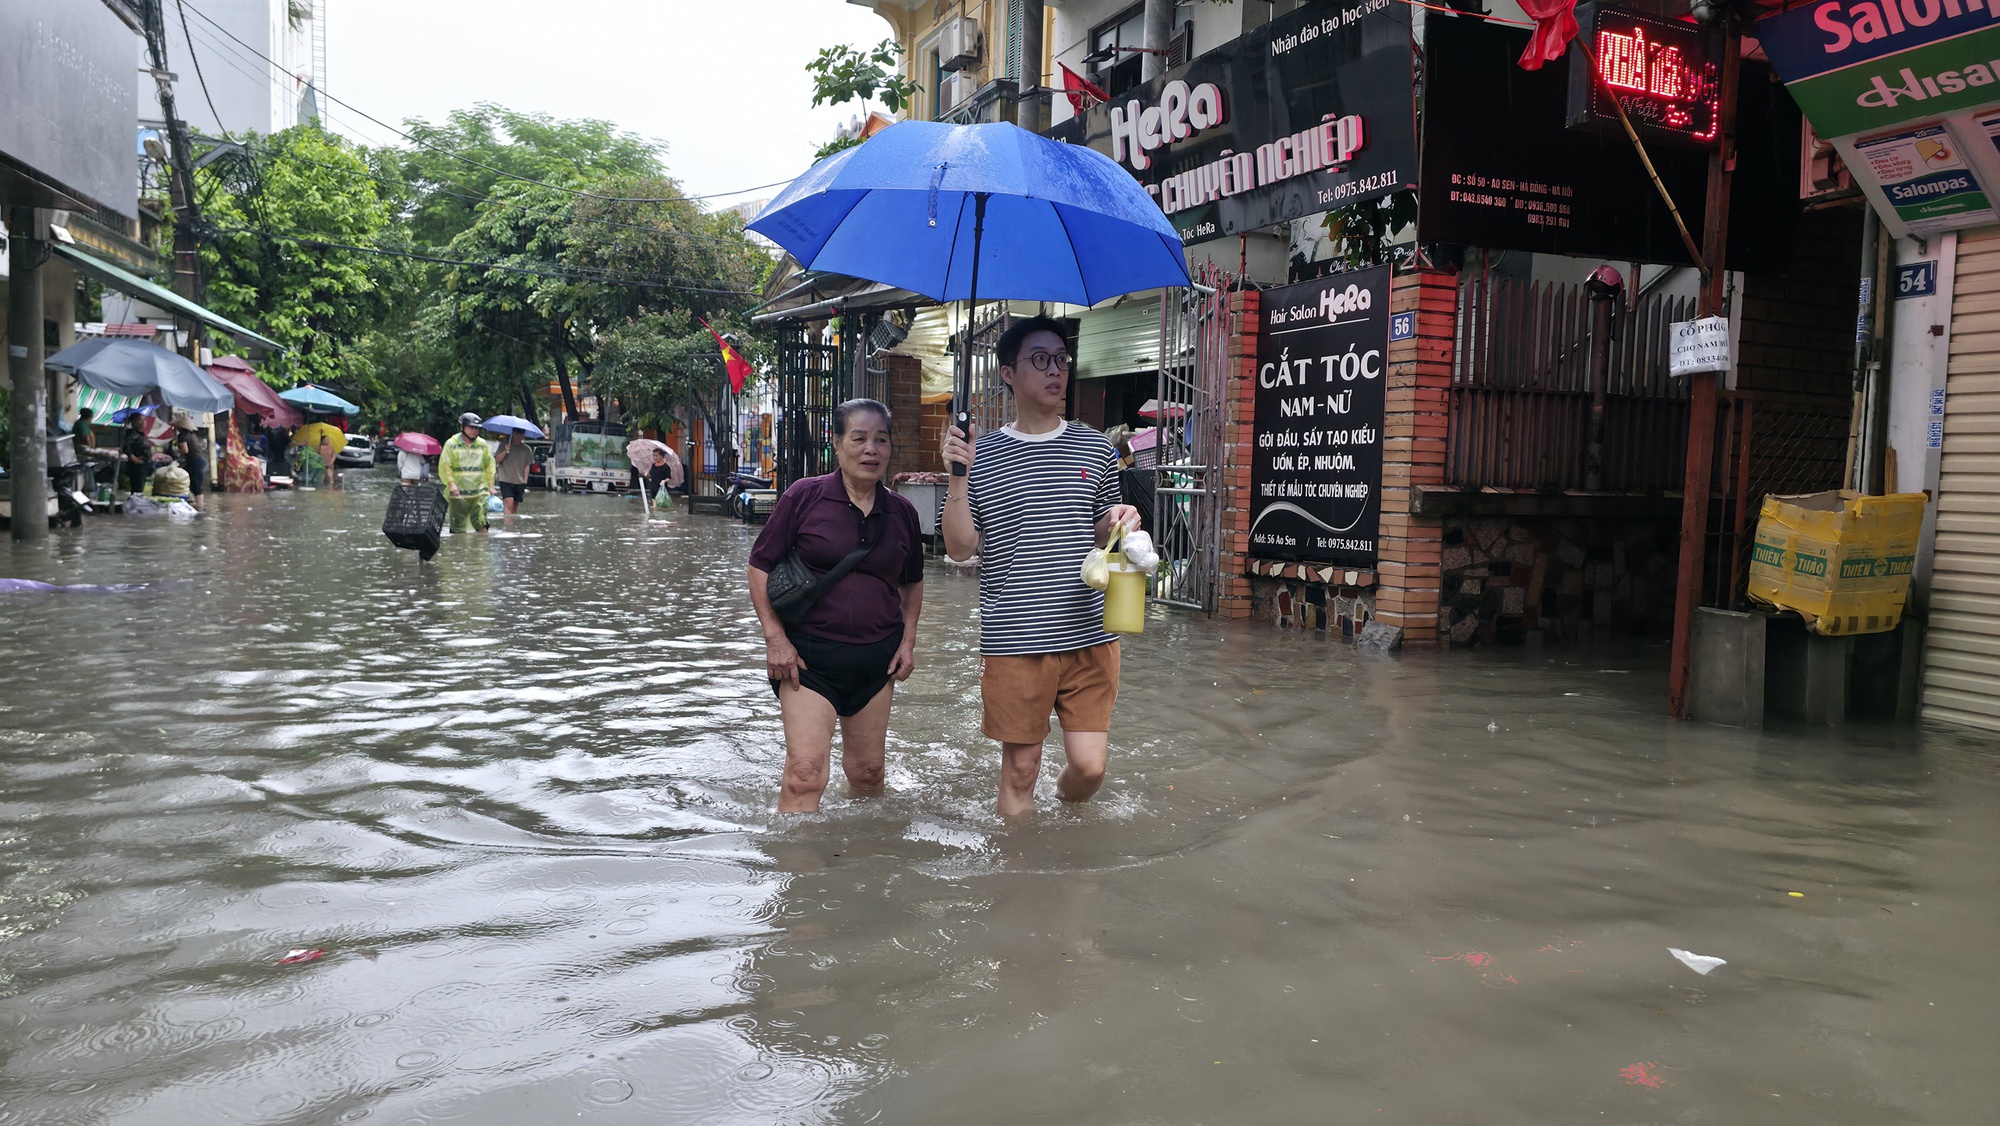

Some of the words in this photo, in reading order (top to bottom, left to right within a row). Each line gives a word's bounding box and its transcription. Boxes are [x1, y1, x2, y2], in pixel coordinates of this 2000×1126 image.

[1271, 33, 1298, 57] Nhận
[1299, 25, 1320, 44] đào
[1321, 16, 1340, 37] tạo
[1342, 4, 1363, 27] học
[1110, 79, 1223, 171] HeRa
[1915, 129, 1927, 138] 20
[1162, 148, 1255, 215] CHUYÊN
[1256, 112, 1364, 188] NGHIỆP
[1318, 191, 1333, 204] Tel:
[1334, 170, 1398, 200] 0975.842.811
[1477, 176, 1486, 187] 50
[1491, 178, 1500, 189] AO
[1501, 179, 1515, 190] SEN
[1892, 176, 1969, 200] Salonpas
[1183, 227, 1195, 241] Tóc
[1196, 221, 1215, 237] HeRa
[1900, 268, 1926, 292] 54
[1270, 308, 1288, 325] Hair
[1290, 304, 1317, 322] Salon
[1319, 284, 1372, 323] HeRa
[1394, 316, 1410, 336] 56
[1677, 345, 1695, 353] CHO
[1697, 340, 1718, 349] NAM
[1260, 346, 1313, 389] CẮT
[1320, 342, 1380, 384] TÓC
[1280, 396, 1314, 418] NAM
[1327, 389, 1353, 414] NỮ
[1303, 426, 1323, 446] SẤY
[1327, 429, 1348, 448] TẠO
[1351, 423, 1376, 445] KIỂU
[1272, 451, 1295, 471] UỐN,
[1297, 453, 1311, 471] ÉP,
[1314, 452, 1356, 472] NHUỘM,
[1261, 479, 1276, 496] THIẾT
[1278, 480, 1286, 496] KẾ
[1305, 481, 1317, 497] TÓC
[1318, 480, 1343, 498] CHUYÊN
[1345, 481, 1368, 499] NGHIỆP
[1254, 534, 1266, 544] Add:
[1267, 534, 1274, 544] 56
[1275, 535, 1284, 545] Ao
[1285, 535, 1296, 546] Sen
[1317, 537, 1327, 548] Tel:
[1328, 538, 1373, 551] 0975.842.811
[1755, 547, 1780, 565] THIÊN
[1842, 562, 1872, 577] THIÊN
